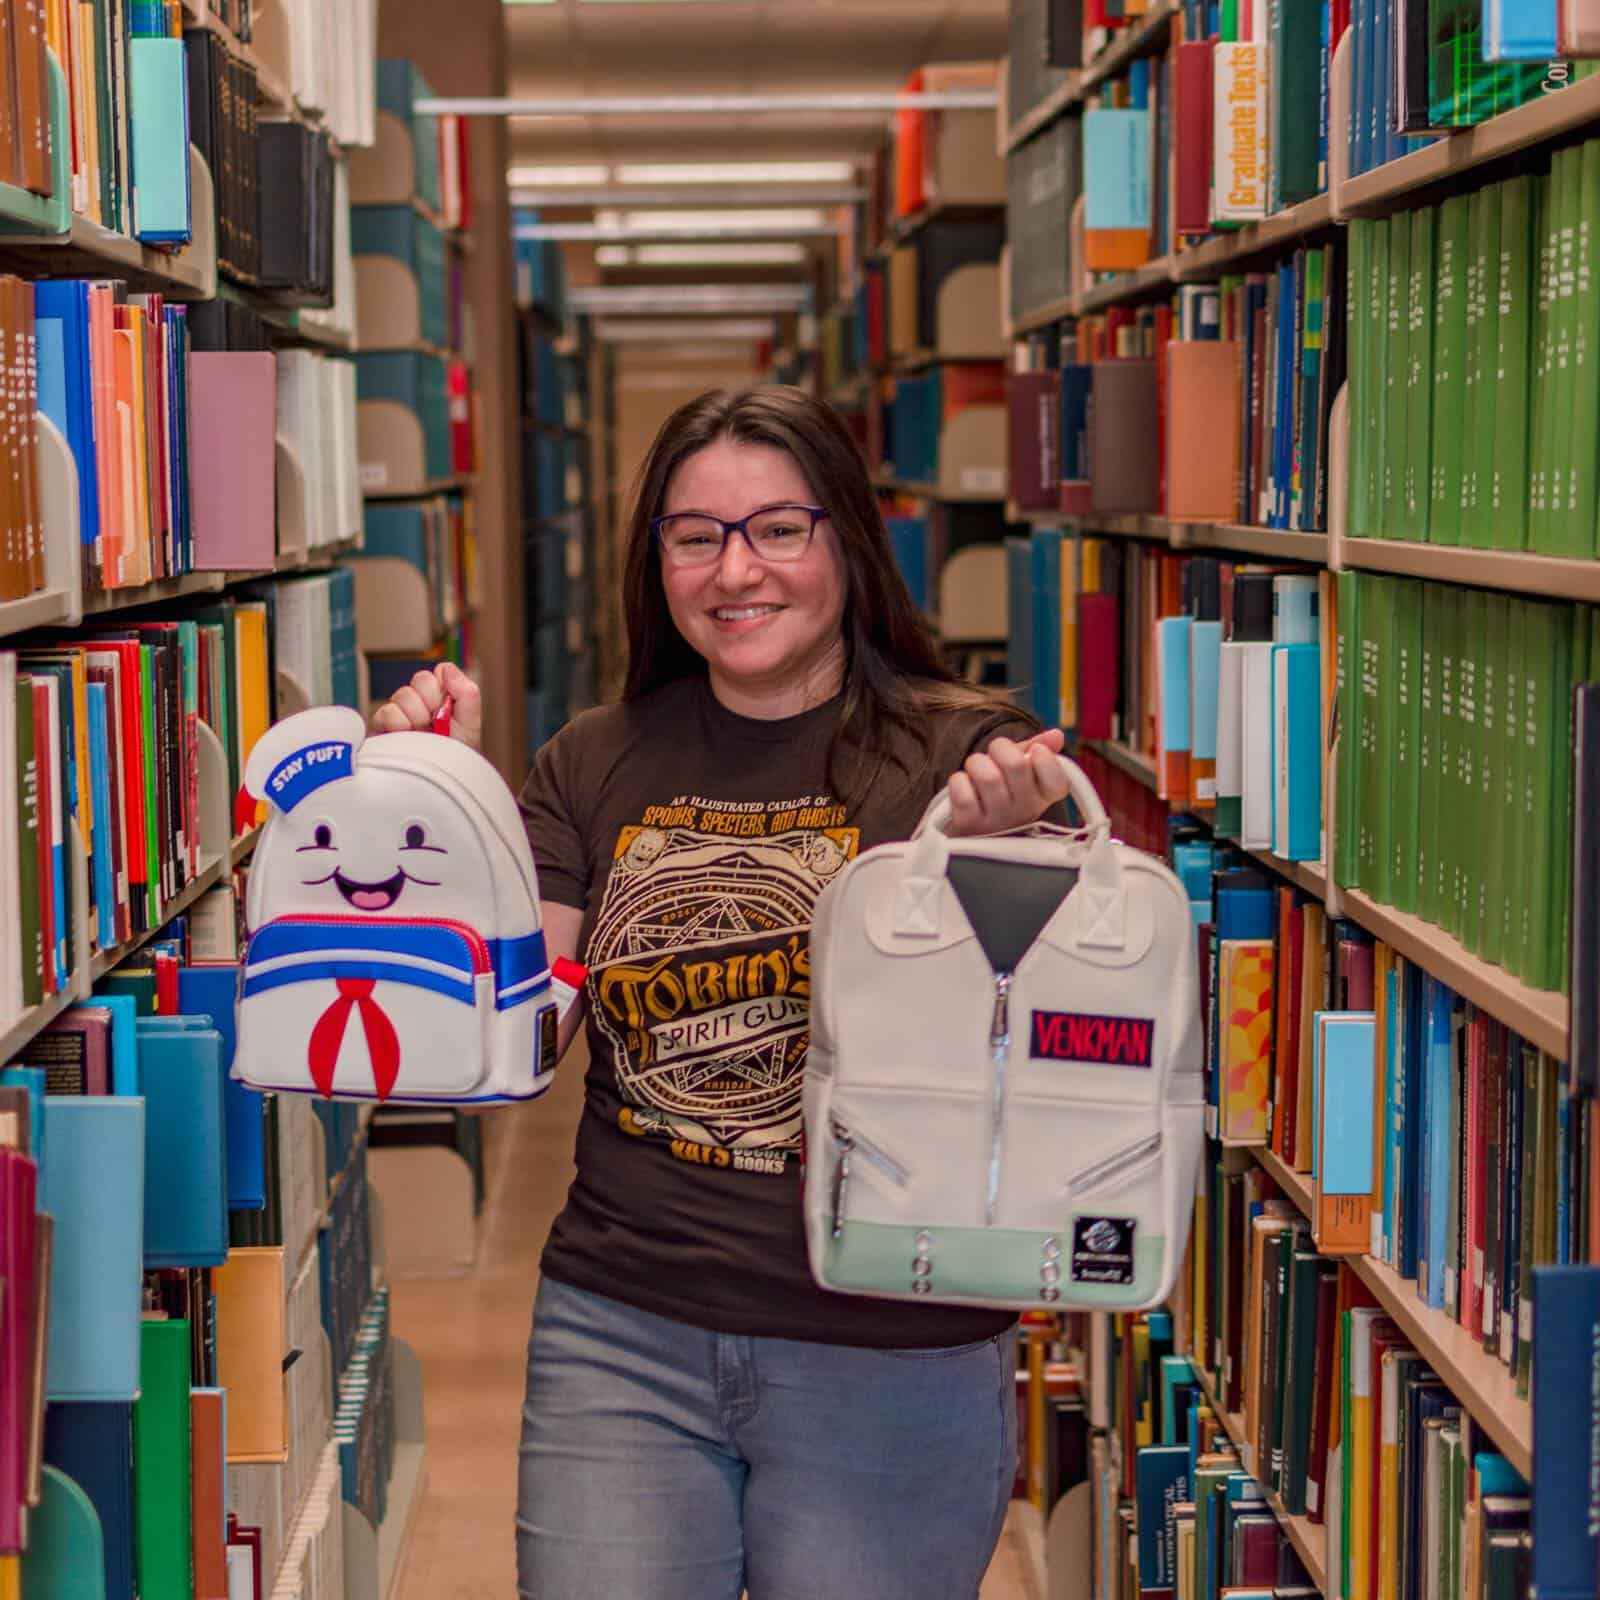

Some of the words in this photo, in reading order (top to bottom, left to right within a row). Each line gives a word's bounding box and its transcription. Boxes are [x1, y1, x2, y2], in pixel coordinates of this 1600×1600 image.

[1228, 46, 1257, 104] Texts
[1228, 106, 1257, 206] Graduate
[271, 757, 303, 792] STAY
[305, 745, 345, 766] PUFT
[671, 796, 688, 806] AN
[690, 796, 764, 813] ILLUSTRATED
[767, 796, 811, 811] CATALOG
[814, 796, 830, 806] OF
[700, 811, 766, 836] SPECTERS,
[770, 810, 797, 833] AND
[796, 806, 846, 827] GHOSTS
[600, 936, 809, 1045] TOBIN'S
[658, 1012, 736, 1050] SPIRIT
[1036, 1013, 1148, 1064] VENKMAN
[733, 1155, 785, 1175] BOOKS
